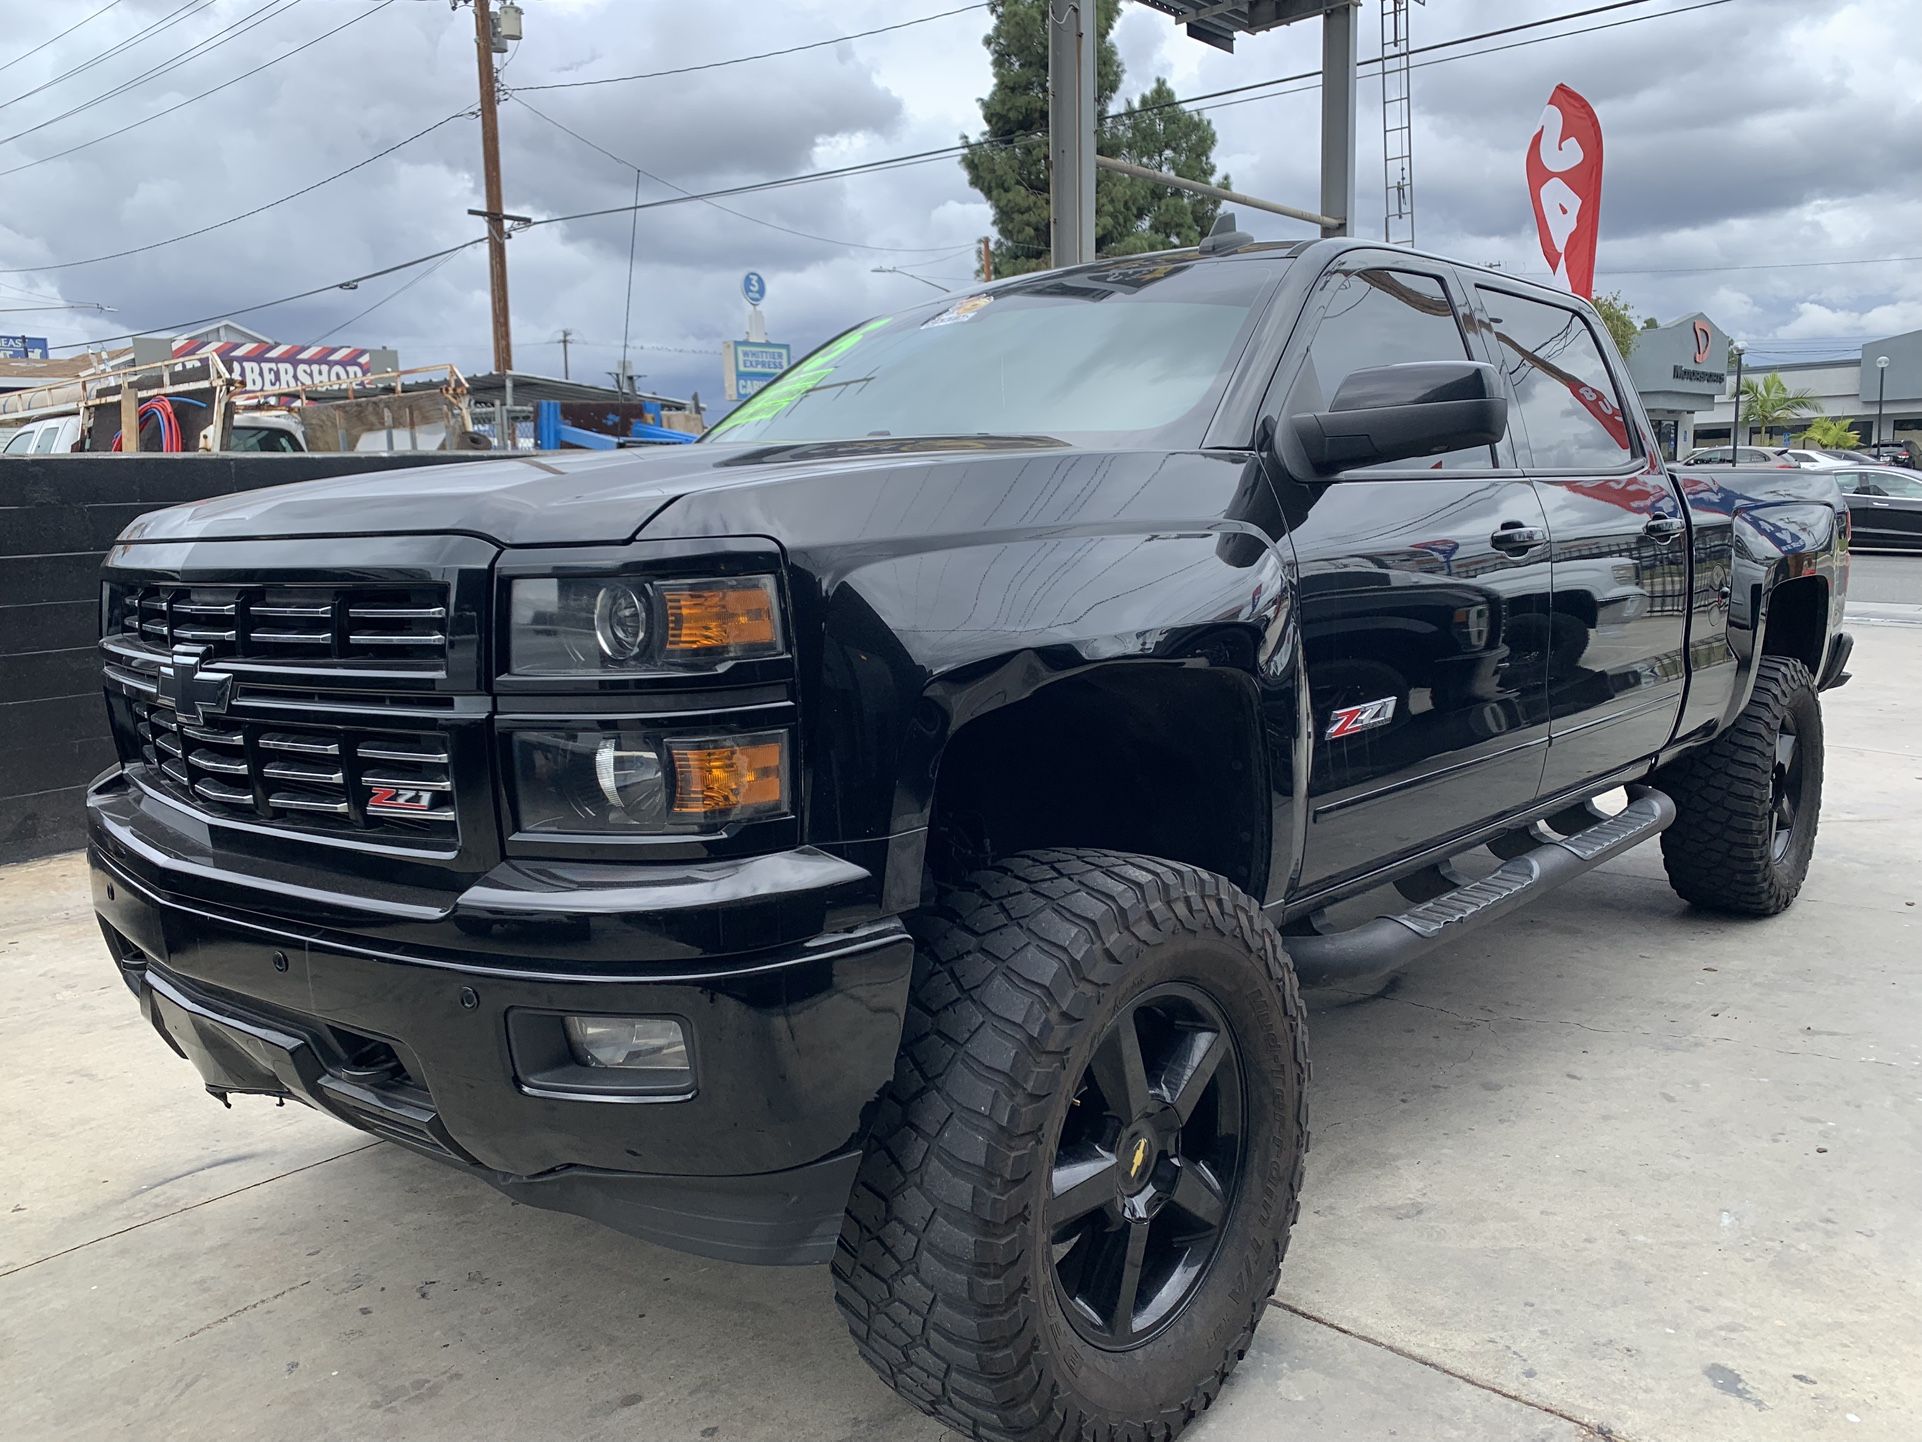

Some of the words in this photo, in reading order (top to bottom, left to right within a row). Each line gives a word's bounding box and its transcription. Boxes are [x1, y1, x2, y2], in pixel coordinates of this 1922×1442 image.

[742, 349, 784, 361] WHITTIER
[743, 359, 784, 370] EXPRESS
[1324, 696, 1398, 741] Z71
[368, 787, 433, 810] Z71
